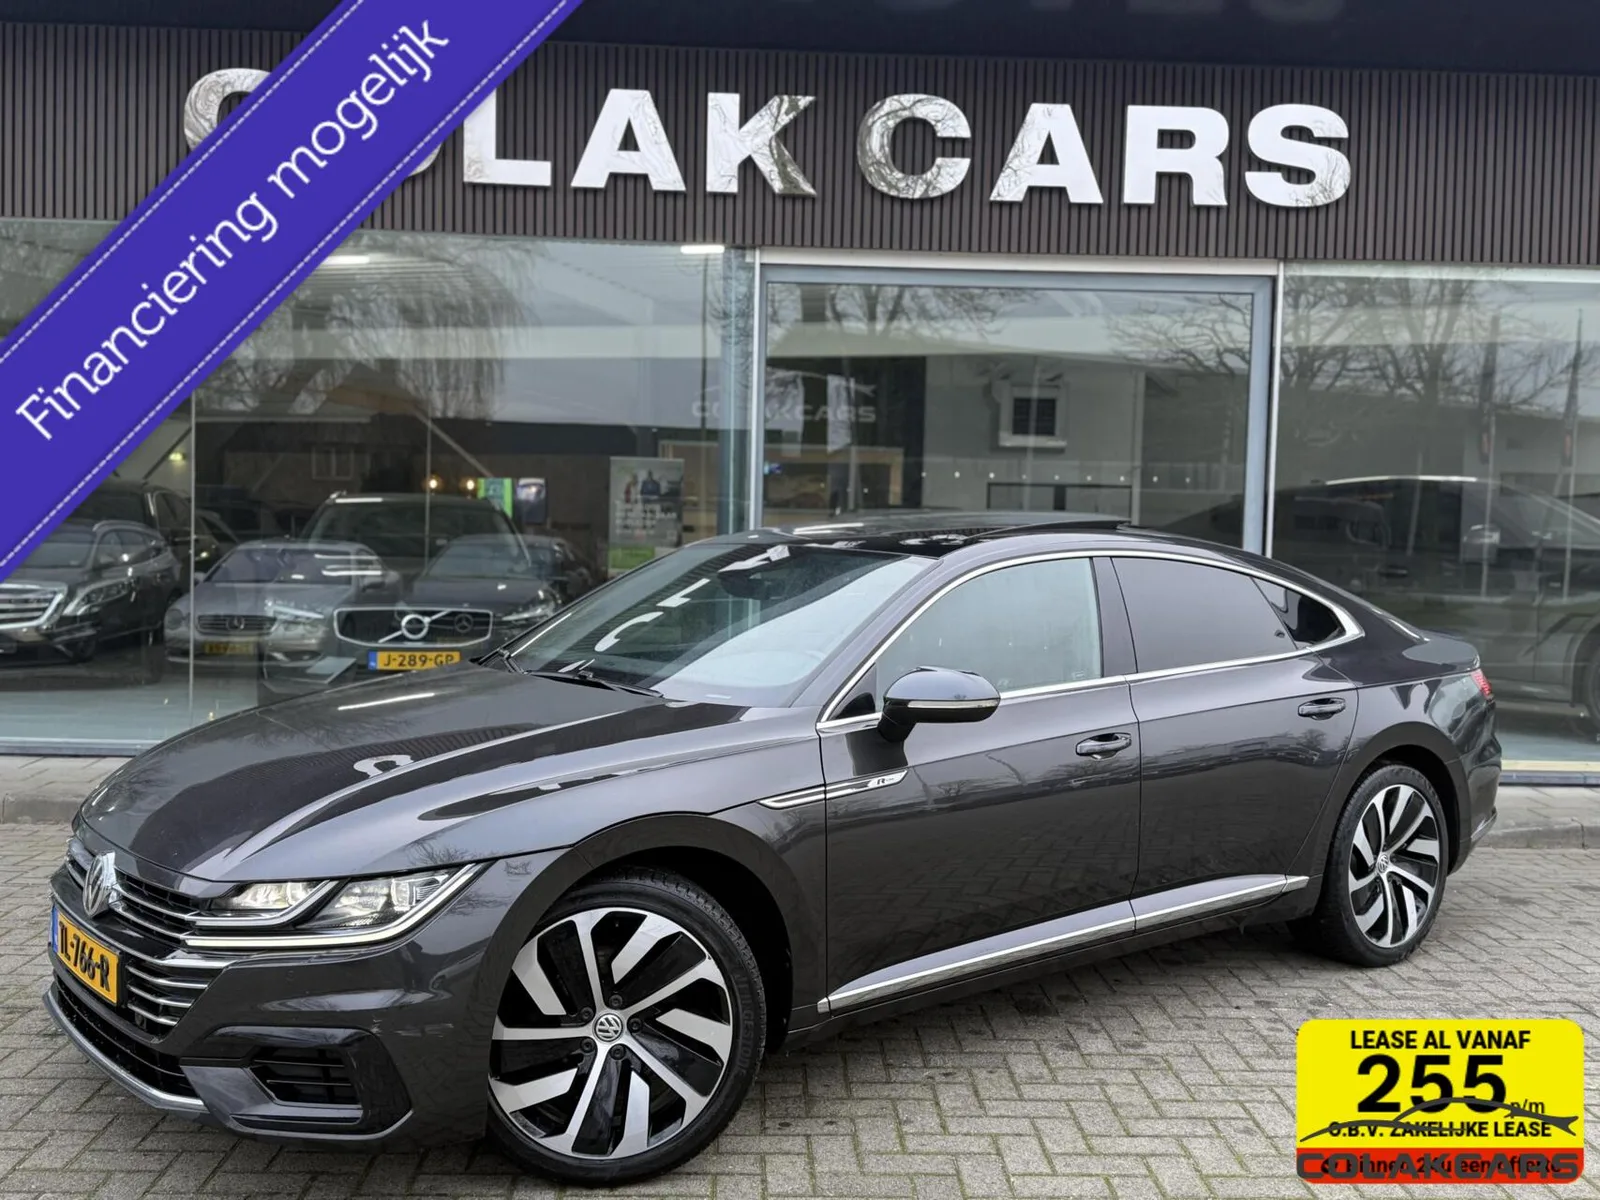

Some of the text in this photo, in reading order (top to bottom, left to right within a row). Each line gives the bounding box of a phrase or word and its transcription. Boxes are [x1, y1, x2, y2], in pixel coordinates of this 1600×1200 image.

[184, 68, 1352, 208] LAK CARS
[383, 653, 455, 667] J-289-GP
